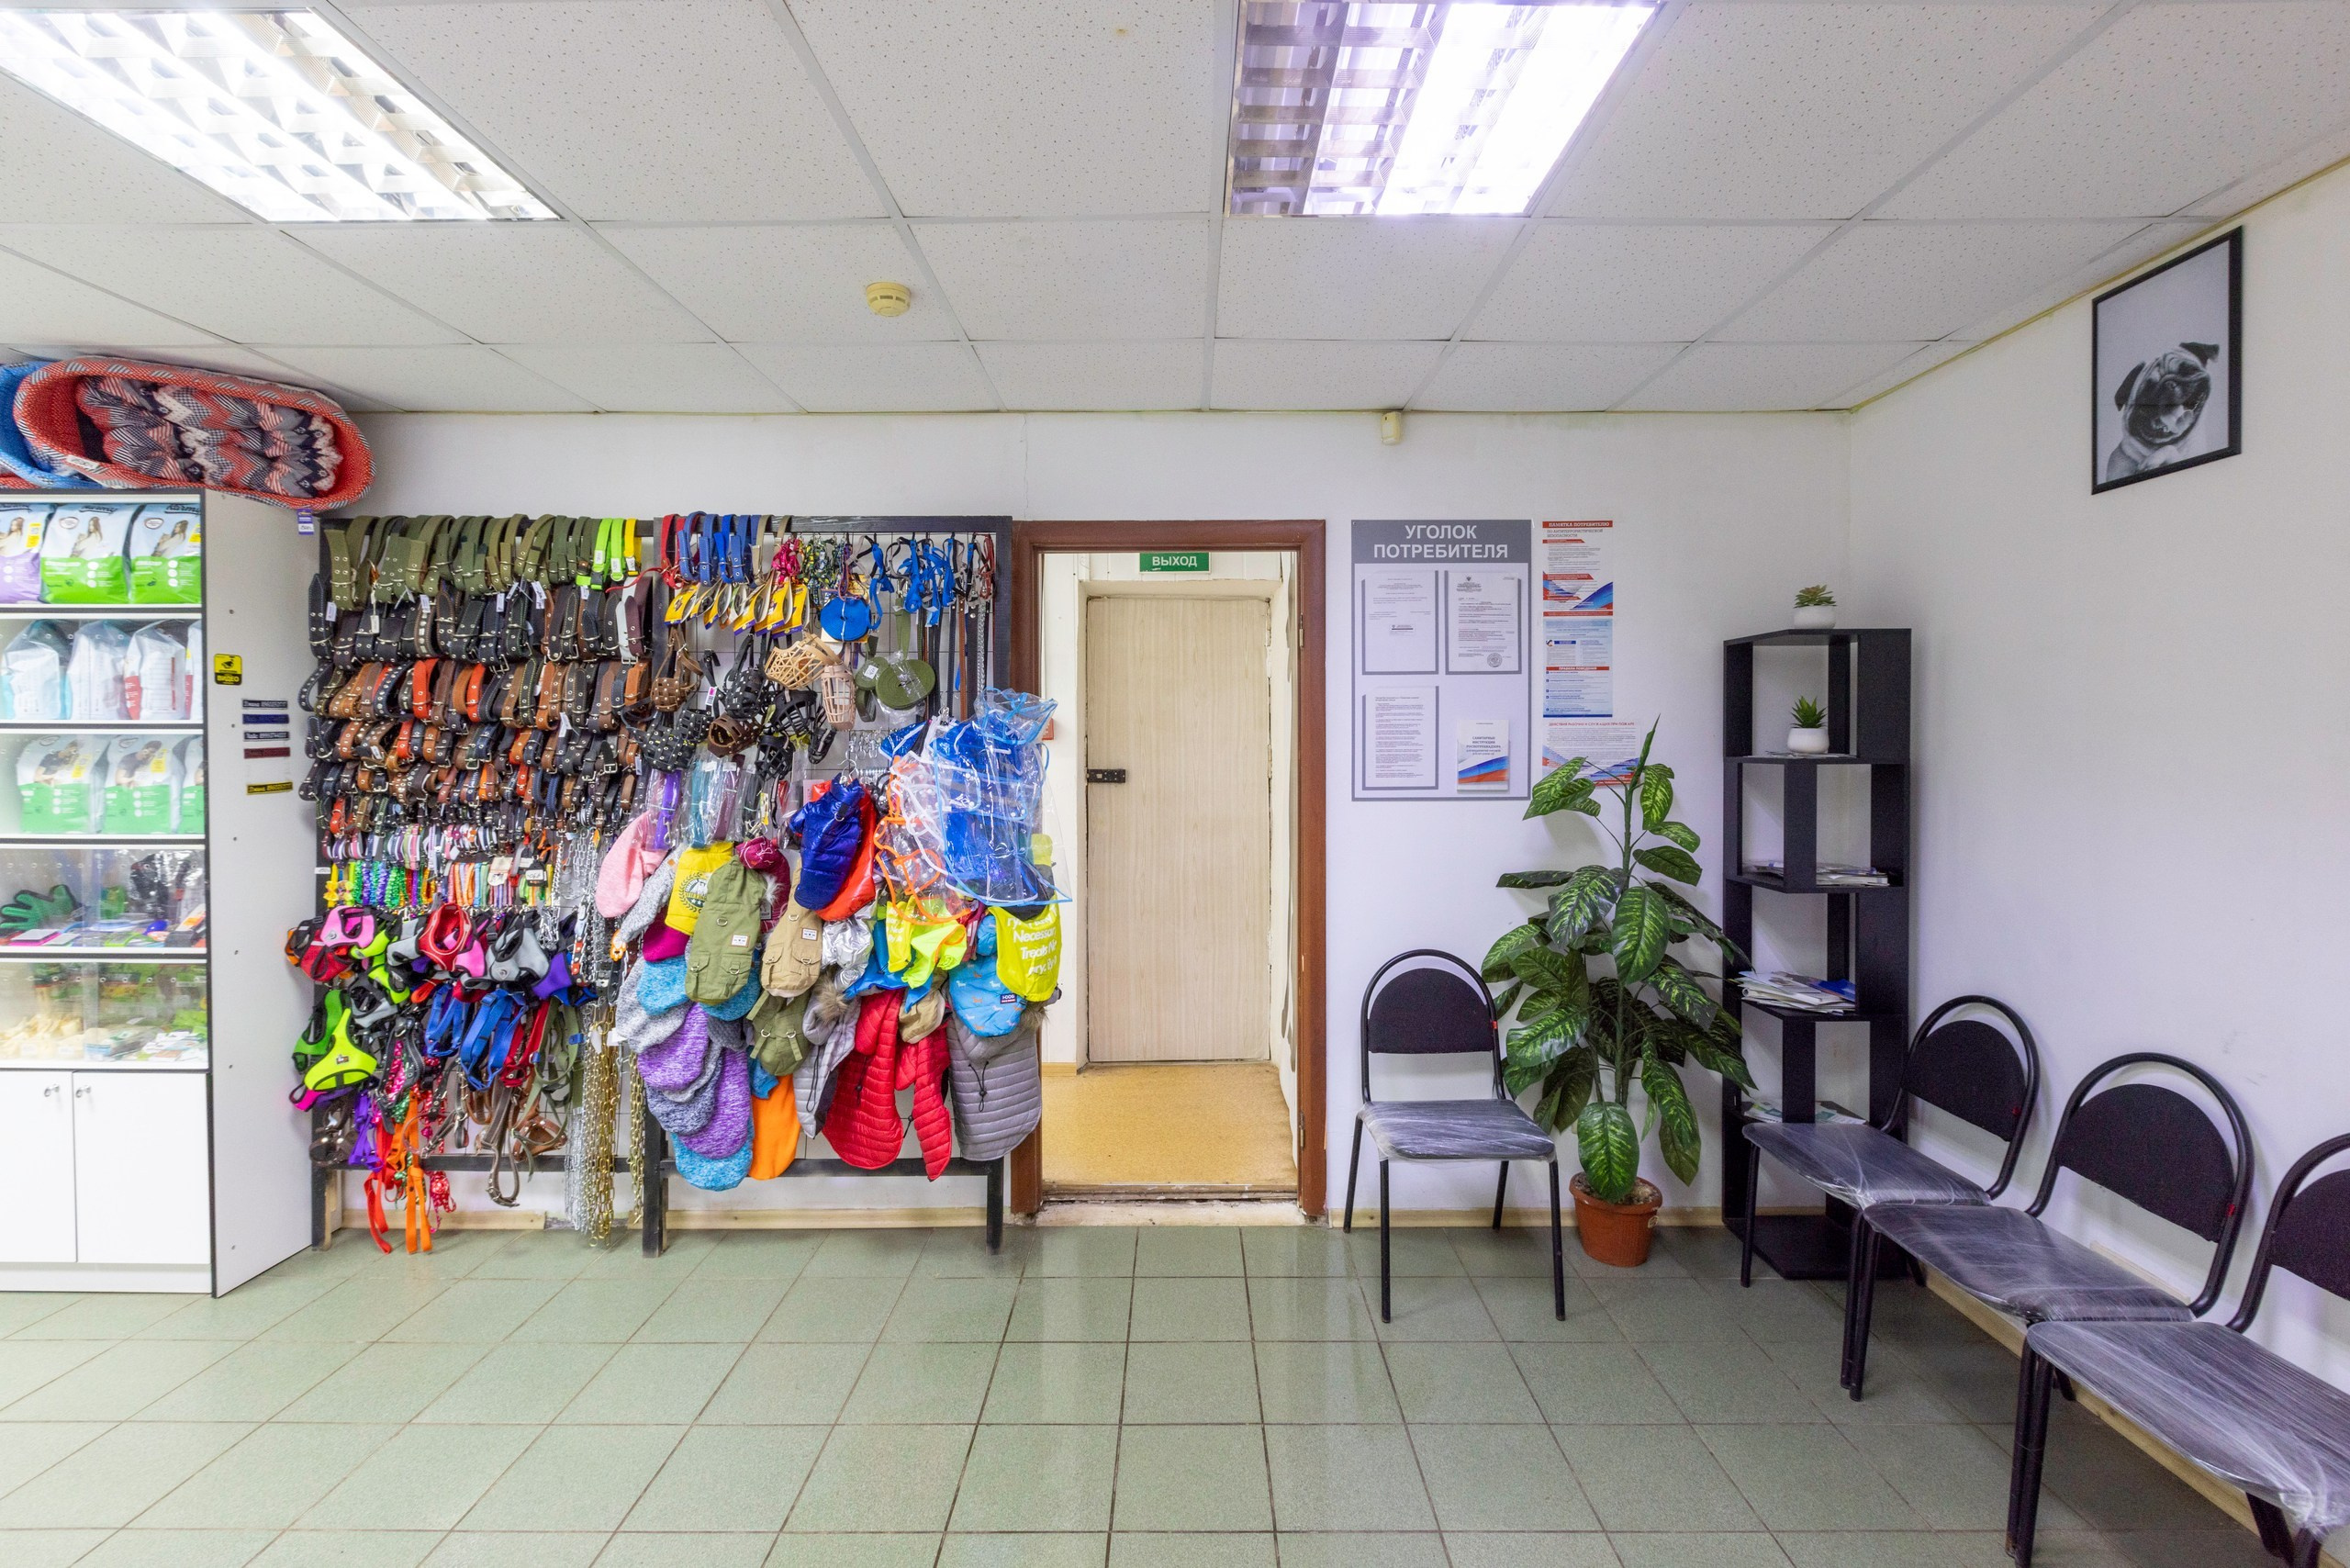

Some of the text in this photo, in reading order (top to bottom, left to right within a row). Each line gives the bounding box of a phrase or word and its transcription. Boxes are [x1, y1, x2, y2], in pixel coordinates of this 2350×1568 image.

[1404, 525, 1477, 540] УГОЛОК
[1373, 543, 1508, 558] ПОТРЕБИТЕЛЯ
[1152, 555, 1198, 567] ВЫХОД
